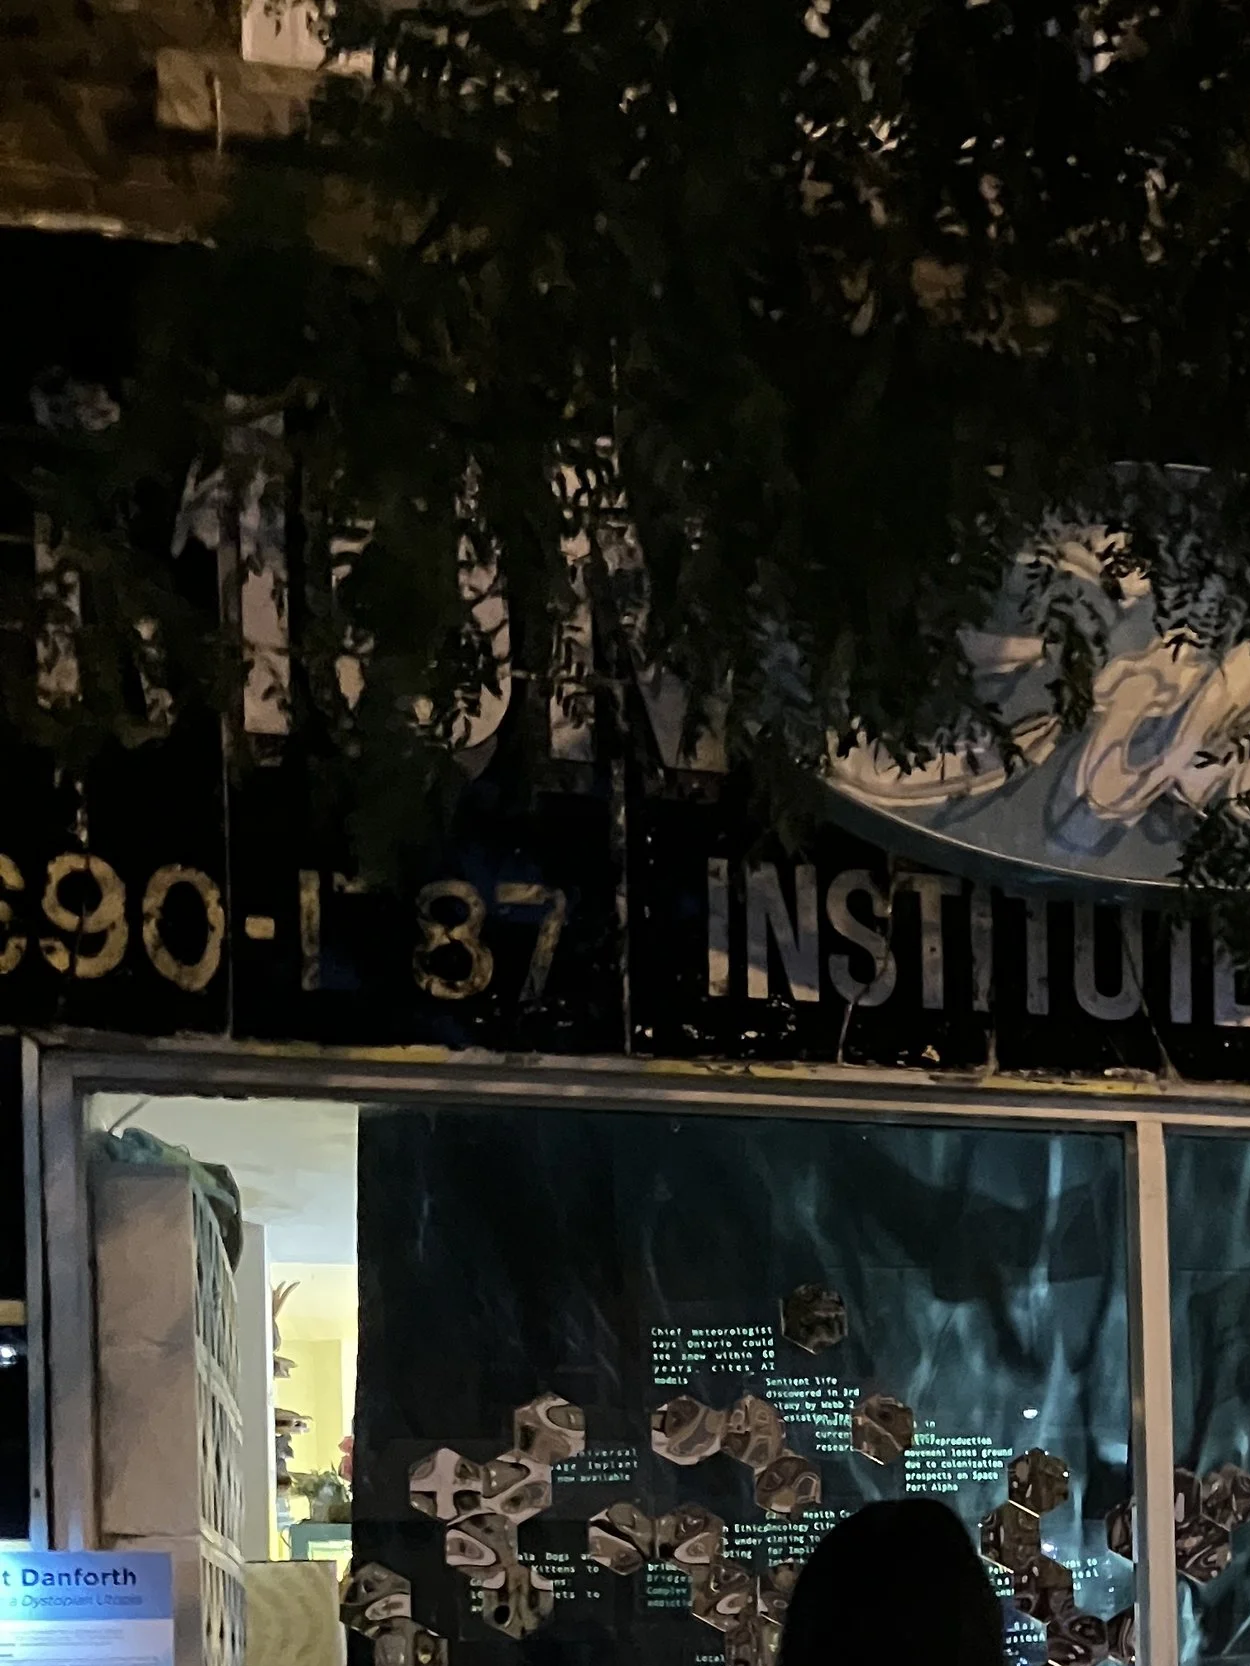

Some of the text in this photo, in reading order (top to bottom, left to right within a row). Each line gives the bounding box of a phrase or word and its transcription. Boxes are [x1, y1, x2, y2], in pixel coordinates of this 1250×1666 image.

[0, 853, 568, 1000] 90-187
[651, 1326, 772, 1337] Chief meteorologist
[652, 1338, 774, 1350] says Ontario could
[653, 1353, 671, 1361] see
[681, 1353, 706, 1361] snow
[715, 1351, 752, 1360] within
[761, 1362, 775, 1371] AI
[815, 1376, 838, 1386] life
[765, 1389, 822, 1399] discovered
[827, 1389, 839, 1397] in
[804, 1401, 817, 1411] by
[821, 1400, 845, 1410] Webb
[815, 1431, 851, 1440] curren
[927, 1436, 993, 1447] eproduction
[904, 1447, 1013, 1458] movement loses ground
[904, 1459, 1004, 1469] due to colonization
[905, 1470, 999, 1481] prospects on Space
[905, 1482, 959, 1492] Port Alpha
[734, 1537, 762, 1545] under
[545, 1552, 570, 1562] Dogs
[587, 1565, 599, 1574] to
[21, 1567, 137, 1587] Danforth
